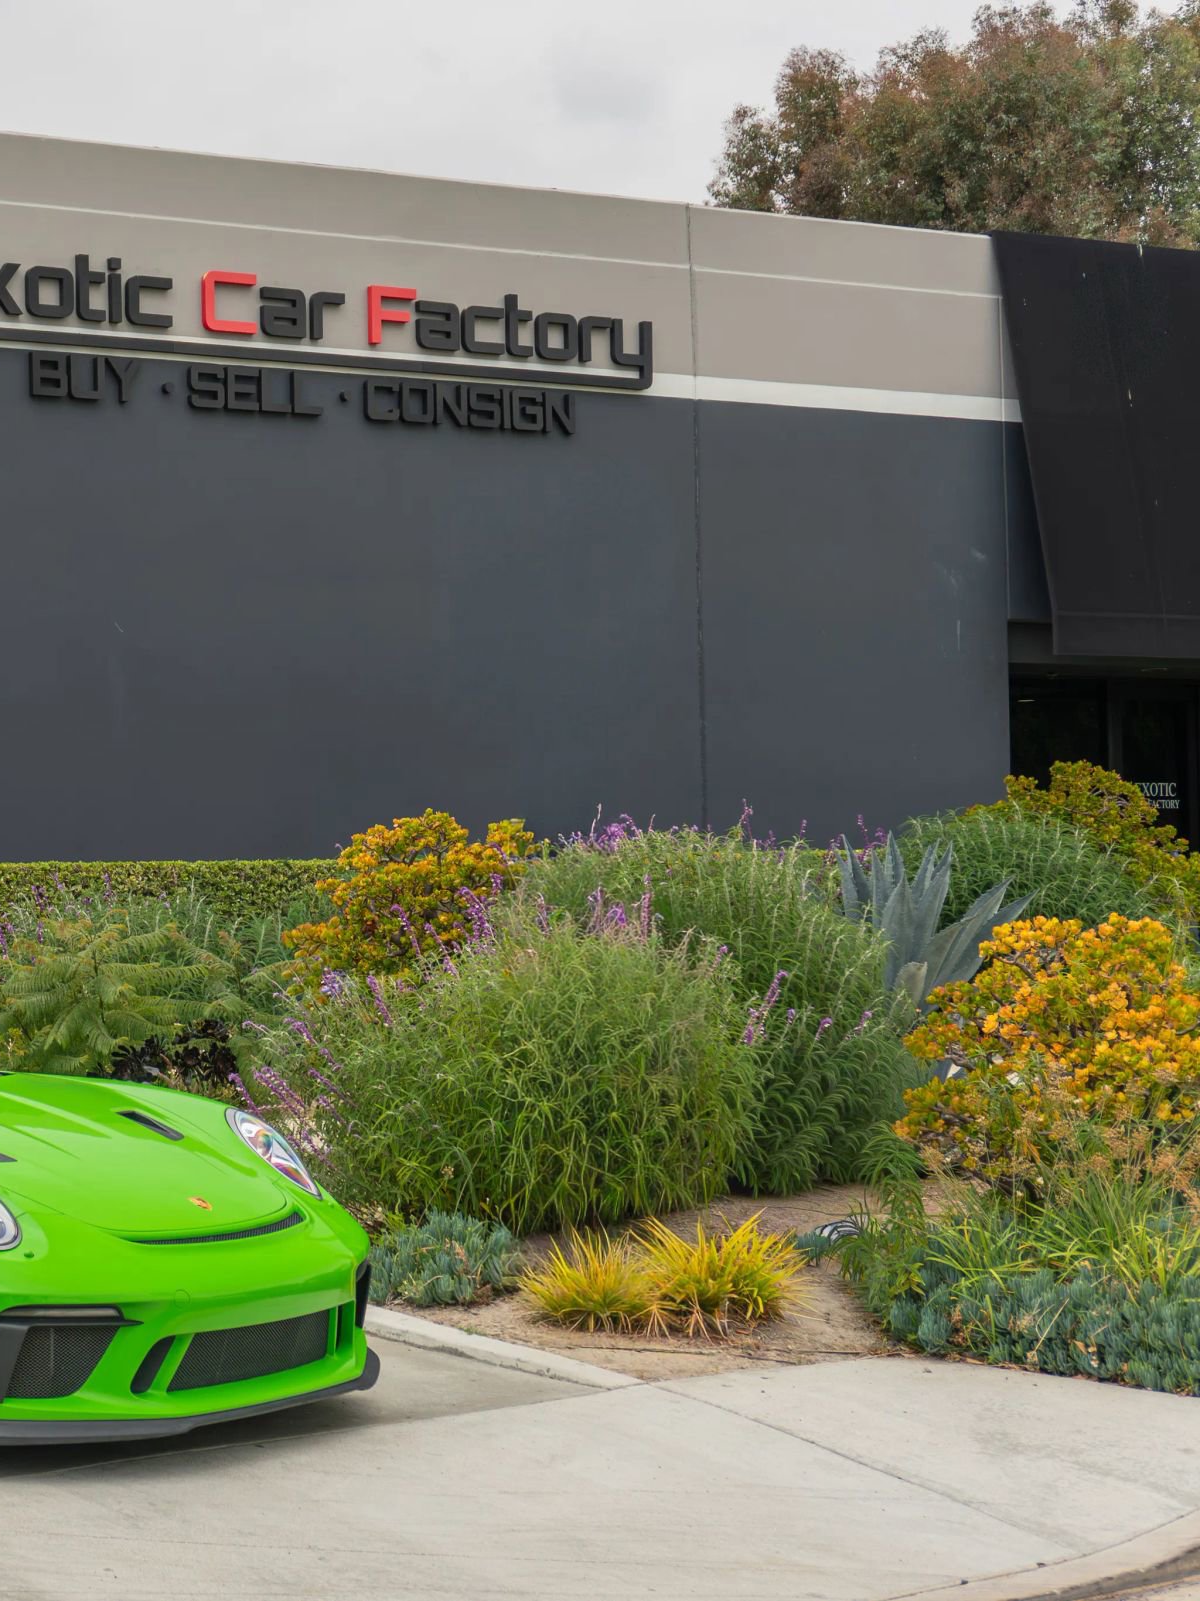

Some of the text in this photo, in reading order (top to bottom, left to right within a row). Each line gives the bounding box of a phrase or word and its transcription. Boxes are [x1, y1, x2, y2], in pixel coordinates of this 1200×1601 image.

[201, 270, 346, 340] Car
[367, 284, 653, 390] Factory
[29, 351, 576, 436] BUY SELL CONSIGN
